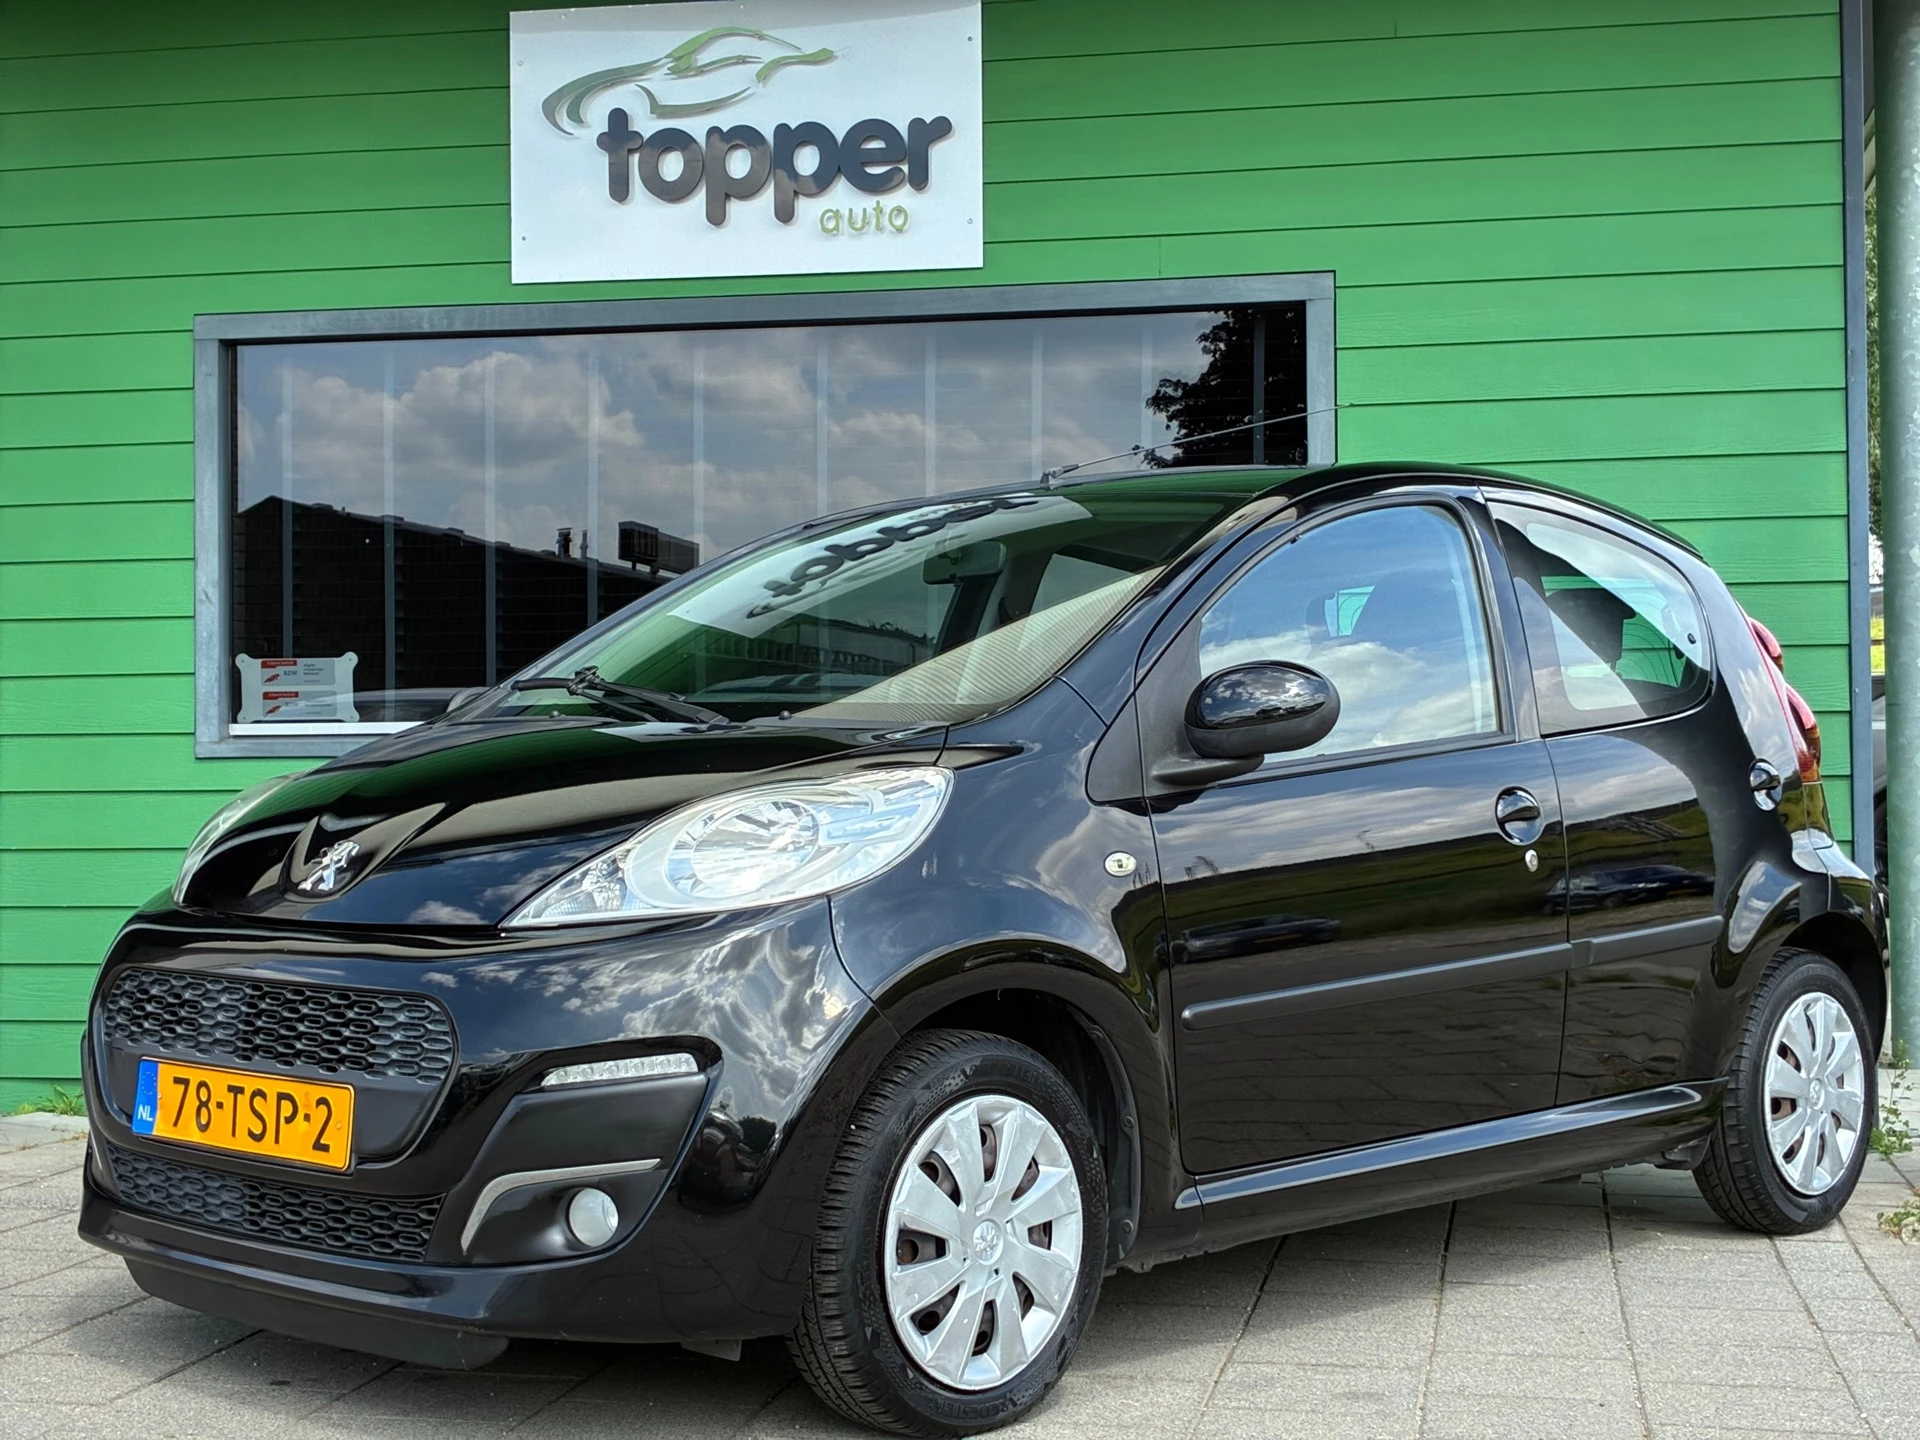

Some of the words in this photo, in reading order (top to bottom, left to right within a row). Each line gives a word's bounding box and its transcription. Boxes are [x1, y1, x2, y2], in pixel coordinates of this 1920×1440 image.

[596, 107, 953, 226] topper
[819, 200, 910, 234] auto
[137, 1104, 153, 1122] NL
[172, 1075, 334, 1153] 78-TSP-2
